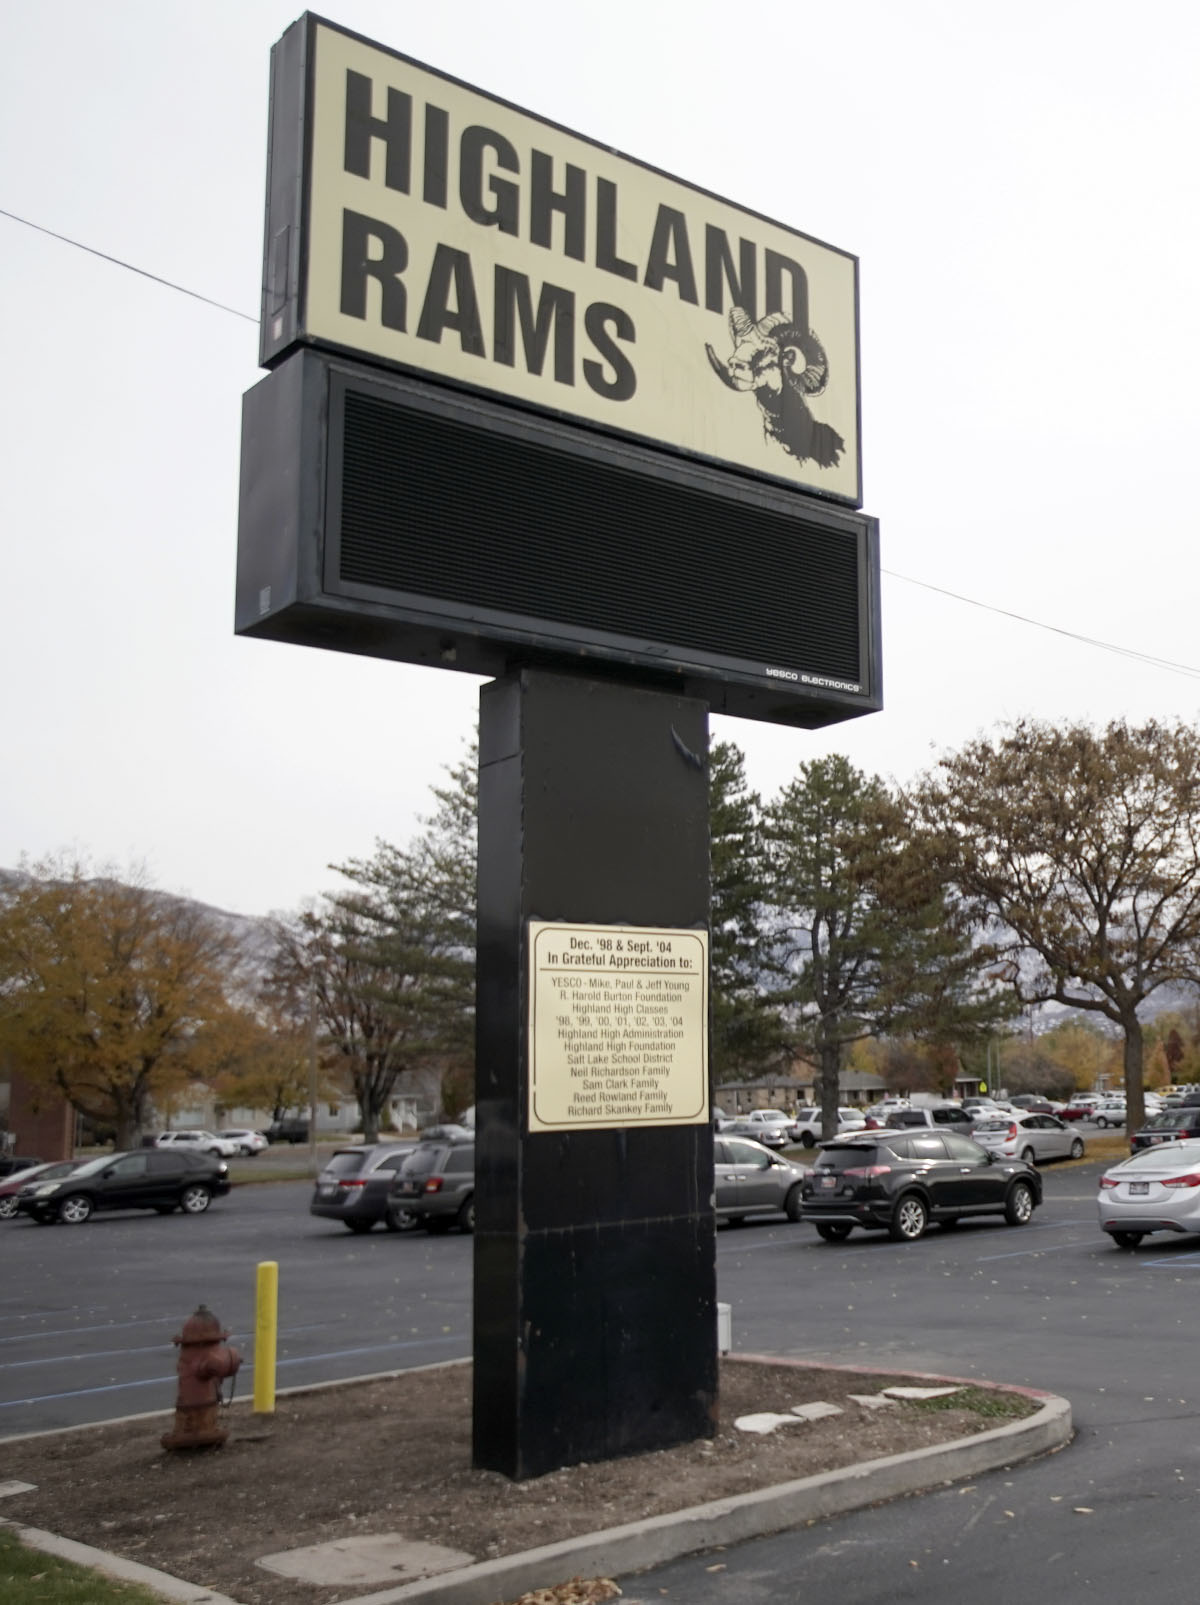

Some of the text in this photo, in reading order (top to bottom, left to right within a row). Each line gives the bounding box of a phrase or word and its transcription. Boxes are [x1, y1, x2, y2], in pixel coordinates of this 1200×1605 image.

[343, 68, 809, 330] HIGHLAND
[340, 208, 637, 402] RAMS
[570, 937, 672, 954] Dec. '98 & Sept. '04
[547, 952, 693, 969] In Grateful Appreciation to:
[552, 977, 582, 988] YESCO
[615, 979, 634, 989] Paul
[637, 980, 643, 989] &
[646, 980, 662, 990] Jeff
[664, 980, 690, 992] Young
[572, 991, 601, 1000] Harold
[604, 991, 632, 1001] Burton
[636, 992, 682, 1002] Foundation
[572, 1003, 668, 1015] Highland High Classes
[558, 1028, 684, 1040] Highland High Administration
[564, 1041, 675, 1052] Highland High Foundation
[568, 1053, 673, 1064] Salt Lake School District
[571, 1065, 670, 1077] Neil Richardson Family
[583, 1078, 659, 1090] Sam Clark Family
[573, 1090, 668, 1103] Reed Rowland Family
[568, 1105, 602, 1116] Richard
[645, 1103, 672, 1113] Family
